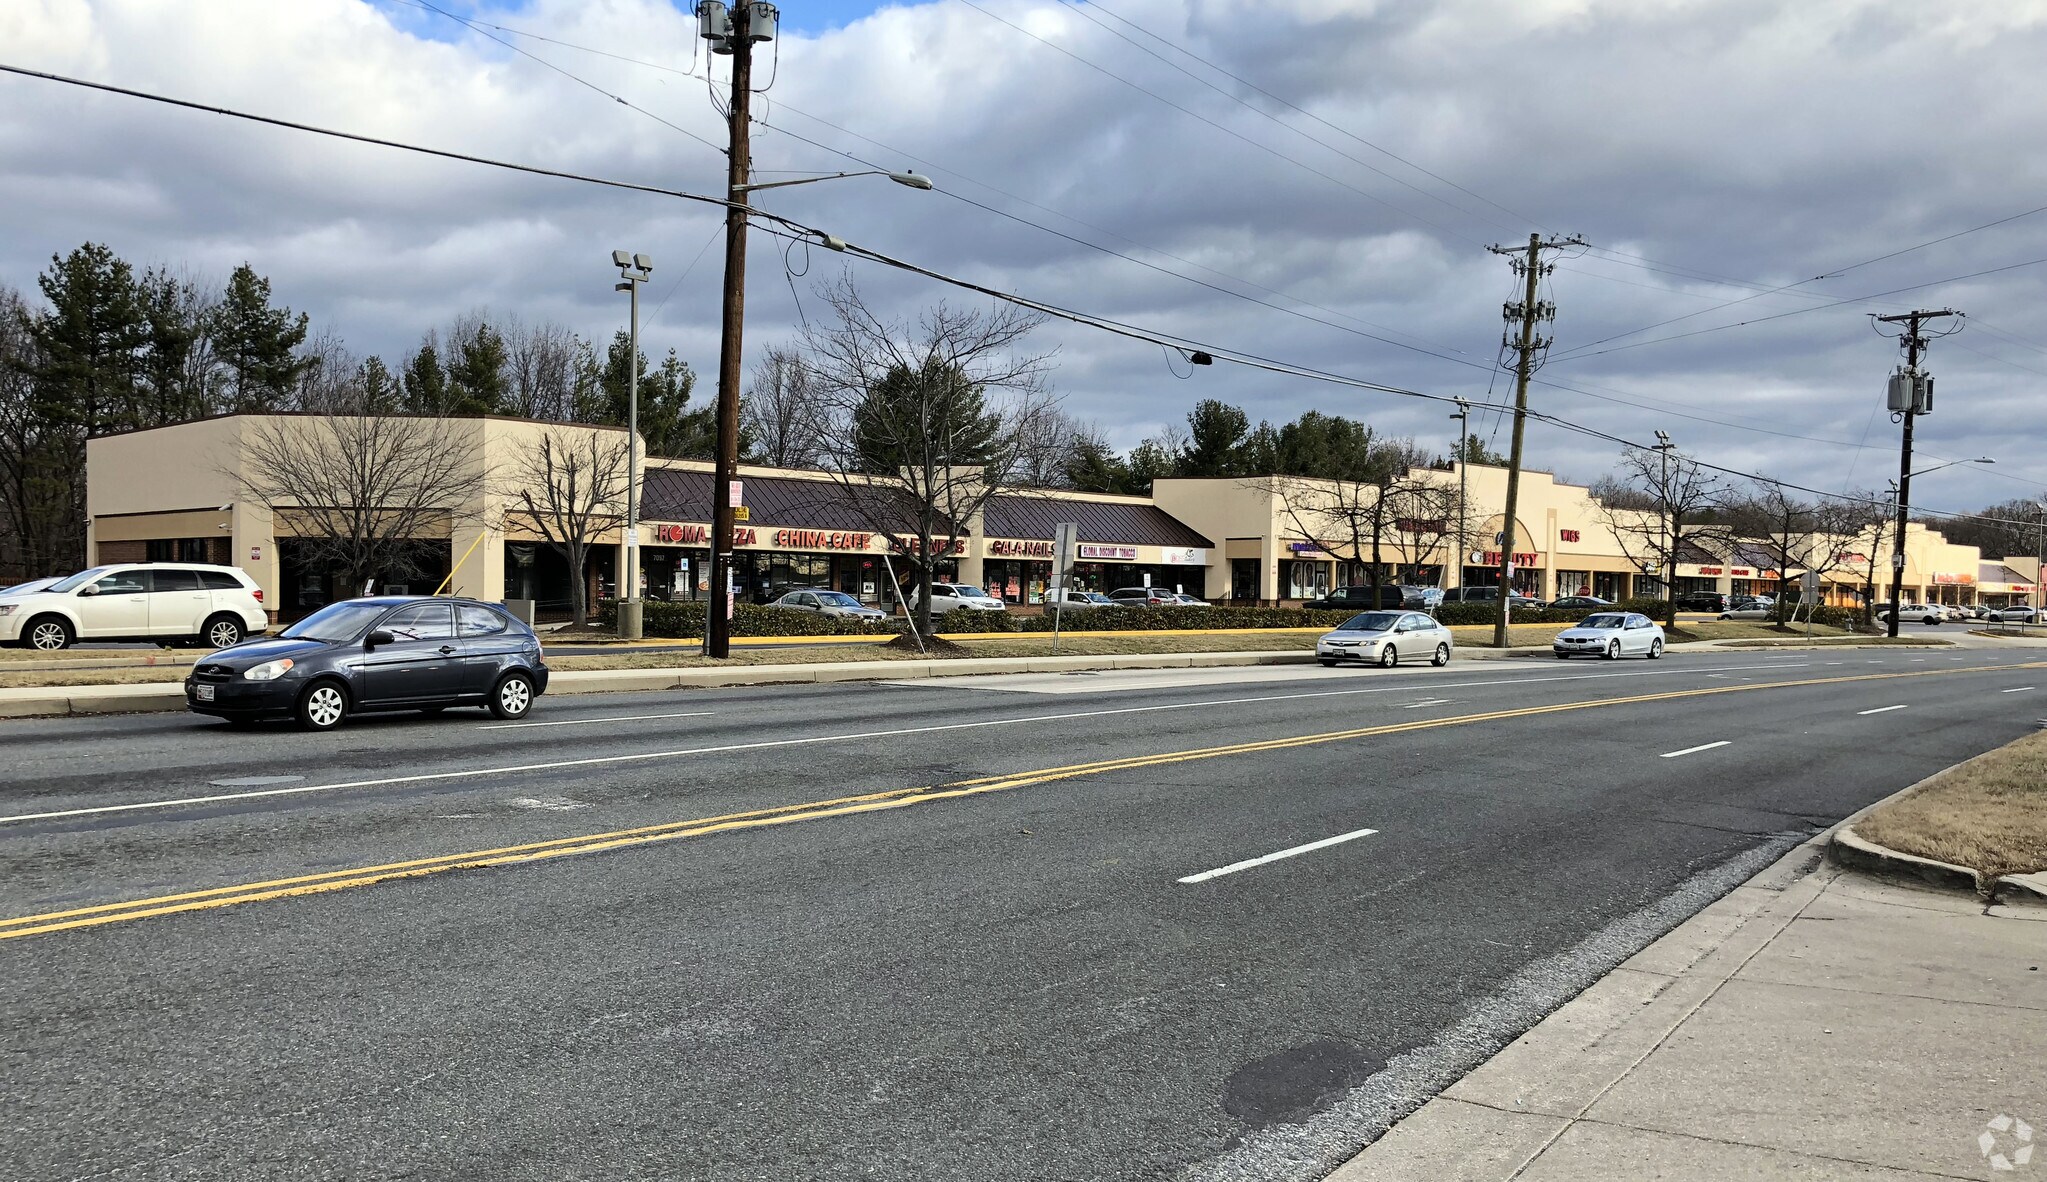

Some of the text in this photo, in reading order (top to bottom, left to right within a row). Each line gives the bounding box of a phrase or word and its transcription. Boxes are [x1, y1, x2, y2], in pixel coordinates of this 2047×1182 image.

[658, 525, 706, 544] ROMA
[777, 530, 871, 549] CHINA CAFE
[1560, 529, 1580, 543] WIGS
[993, 540, 1024, 555] GALA
[1483, 551, 1538, 567] BEUTY
